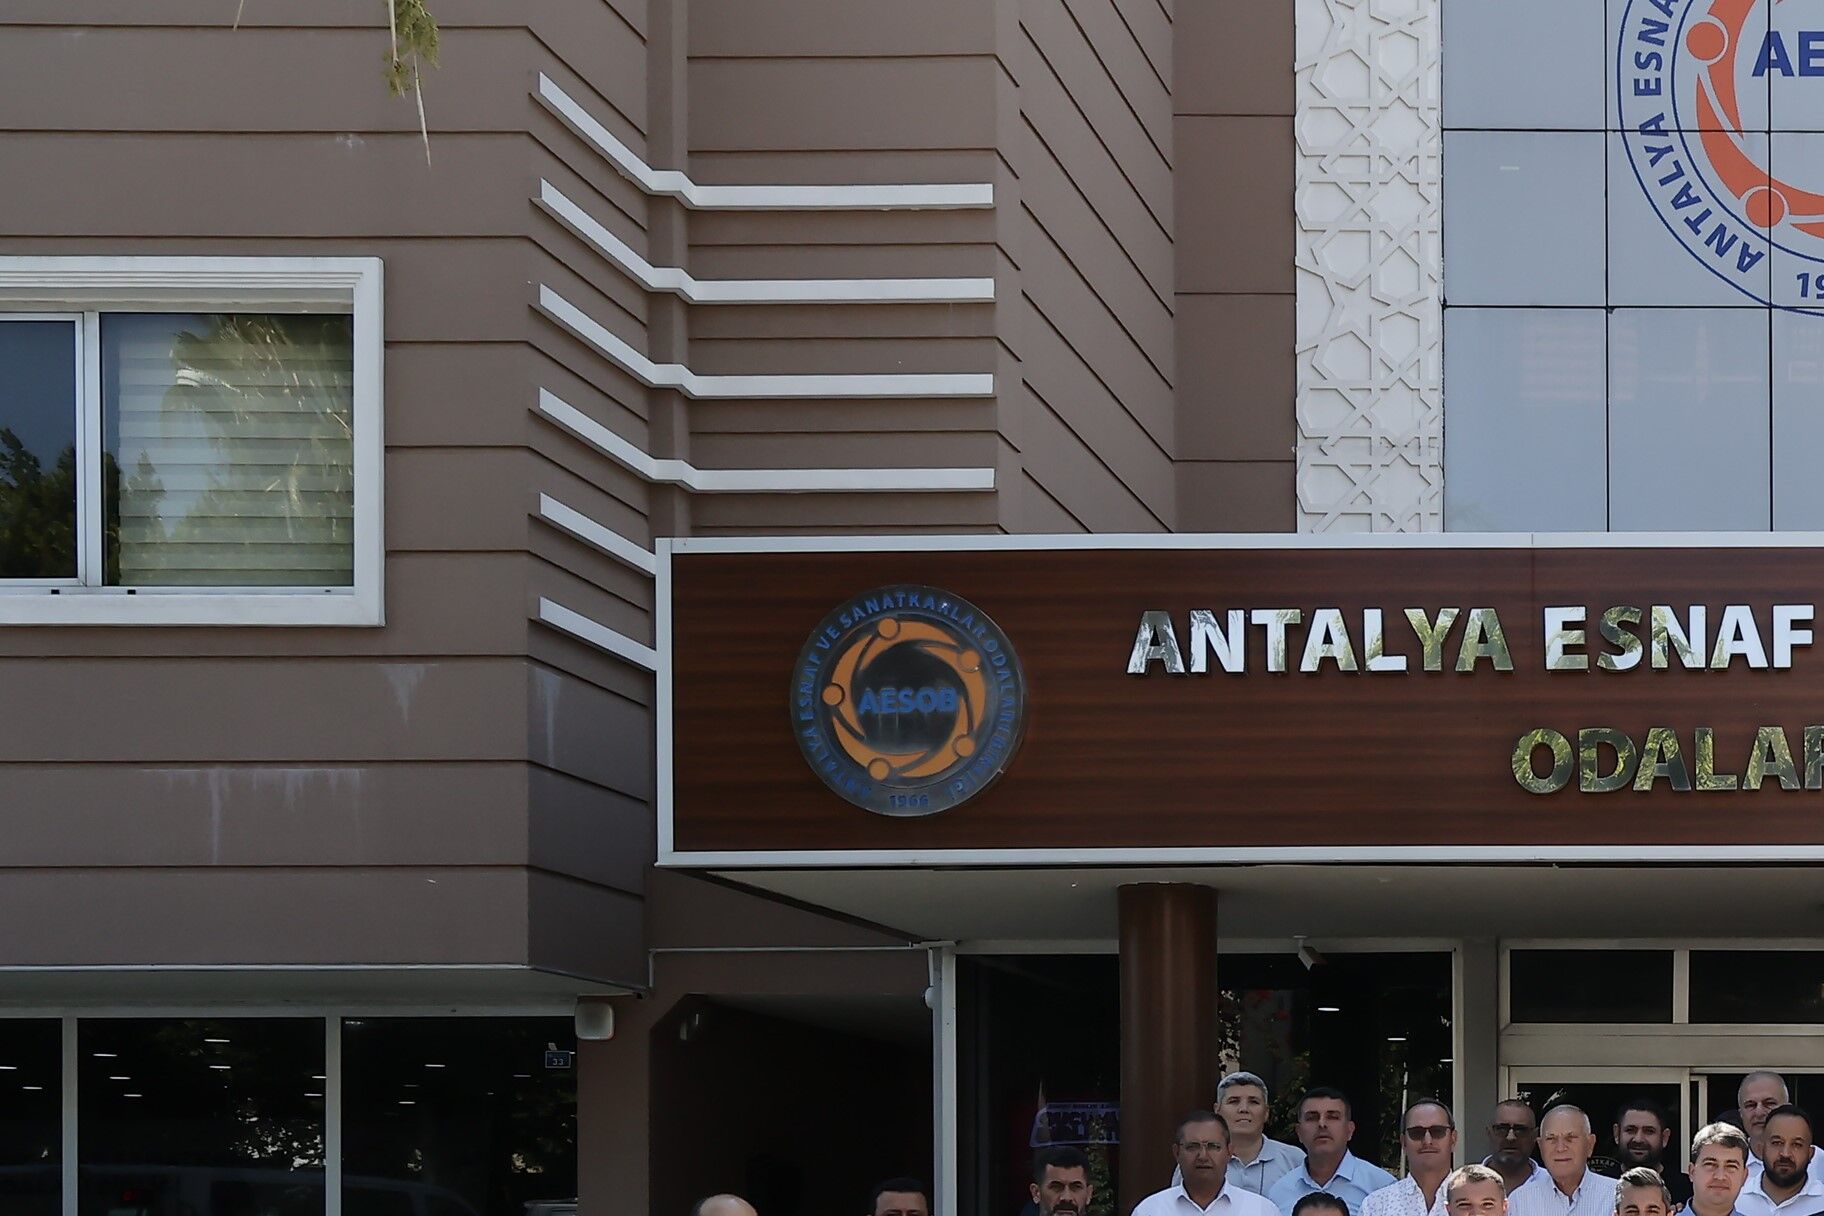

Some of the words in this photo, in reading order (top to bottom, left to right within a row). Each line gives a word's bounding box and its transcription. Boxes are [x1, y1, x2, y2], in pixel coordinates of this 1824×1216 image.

[1639, 112, 1765, 273] ANTALYA
[815, 626, 842, 651] VE
[1126, 607, 1515, 675] ANTALYA
[1543, 603, 1815, 673] ESNAF
[858, 686, 958, 715] AESOB
